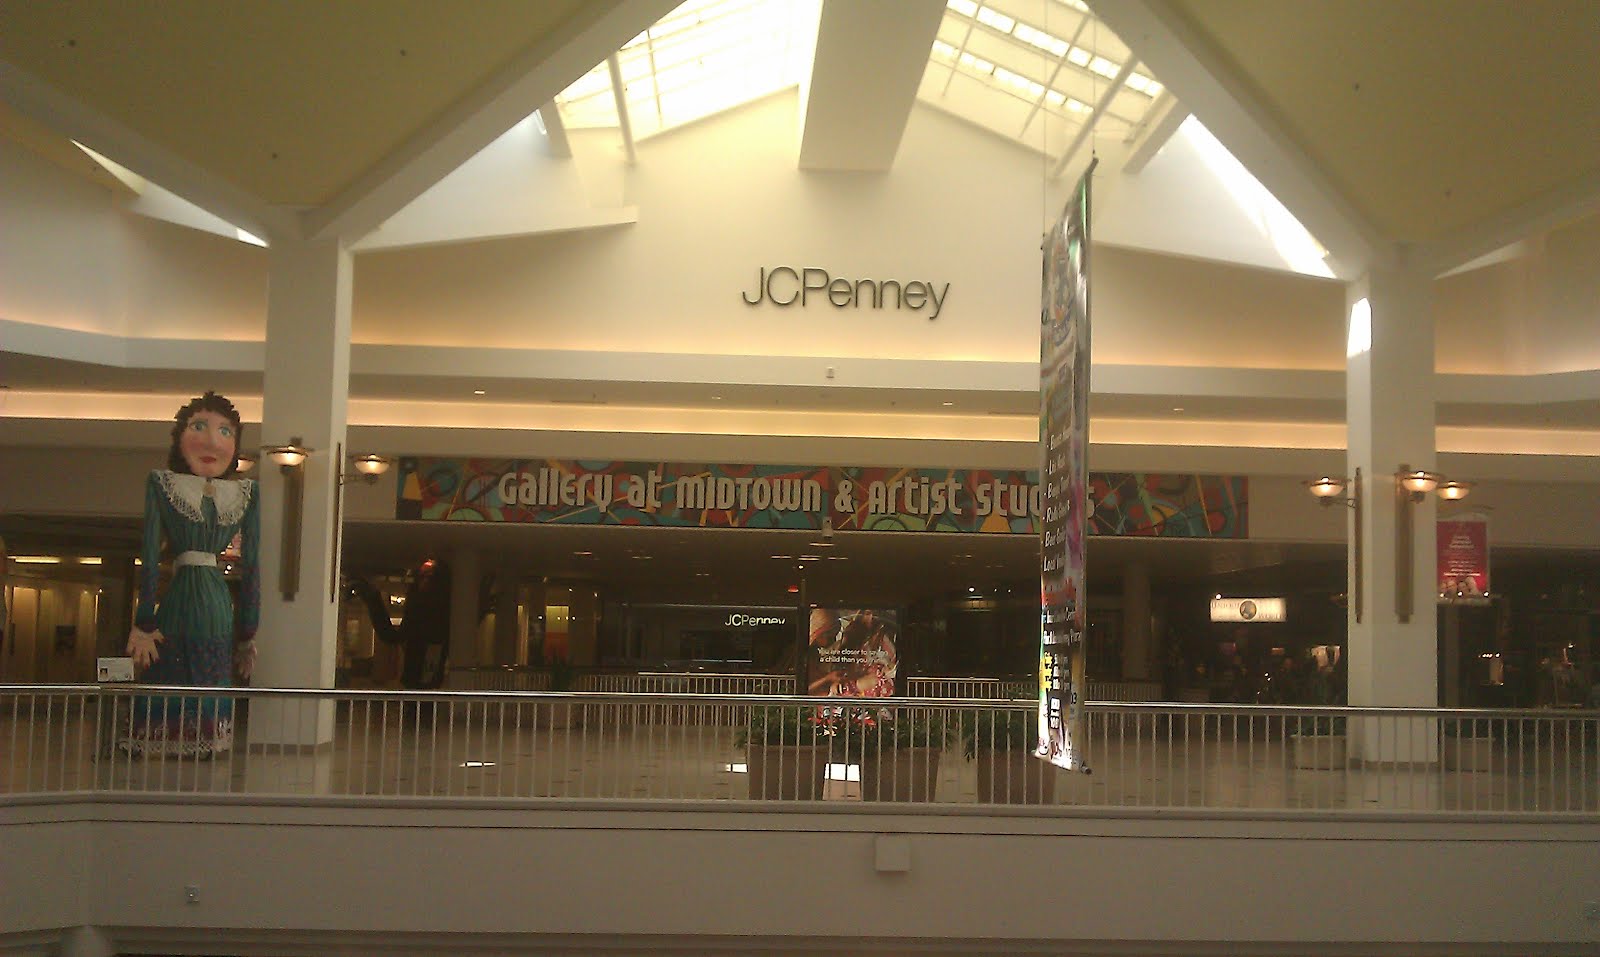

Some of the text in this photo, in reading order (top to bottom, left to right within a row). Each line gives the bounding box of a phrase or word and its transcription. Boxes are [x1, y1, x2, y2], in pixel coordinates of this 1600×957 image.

[742, 265, 950, 321] JCPenney
[499, 468, 613, 513] Gallery
[627, 470, 662, 509] at
[834, 479, 854, 513] &
[724, 614, 786, 627] JCPenney
